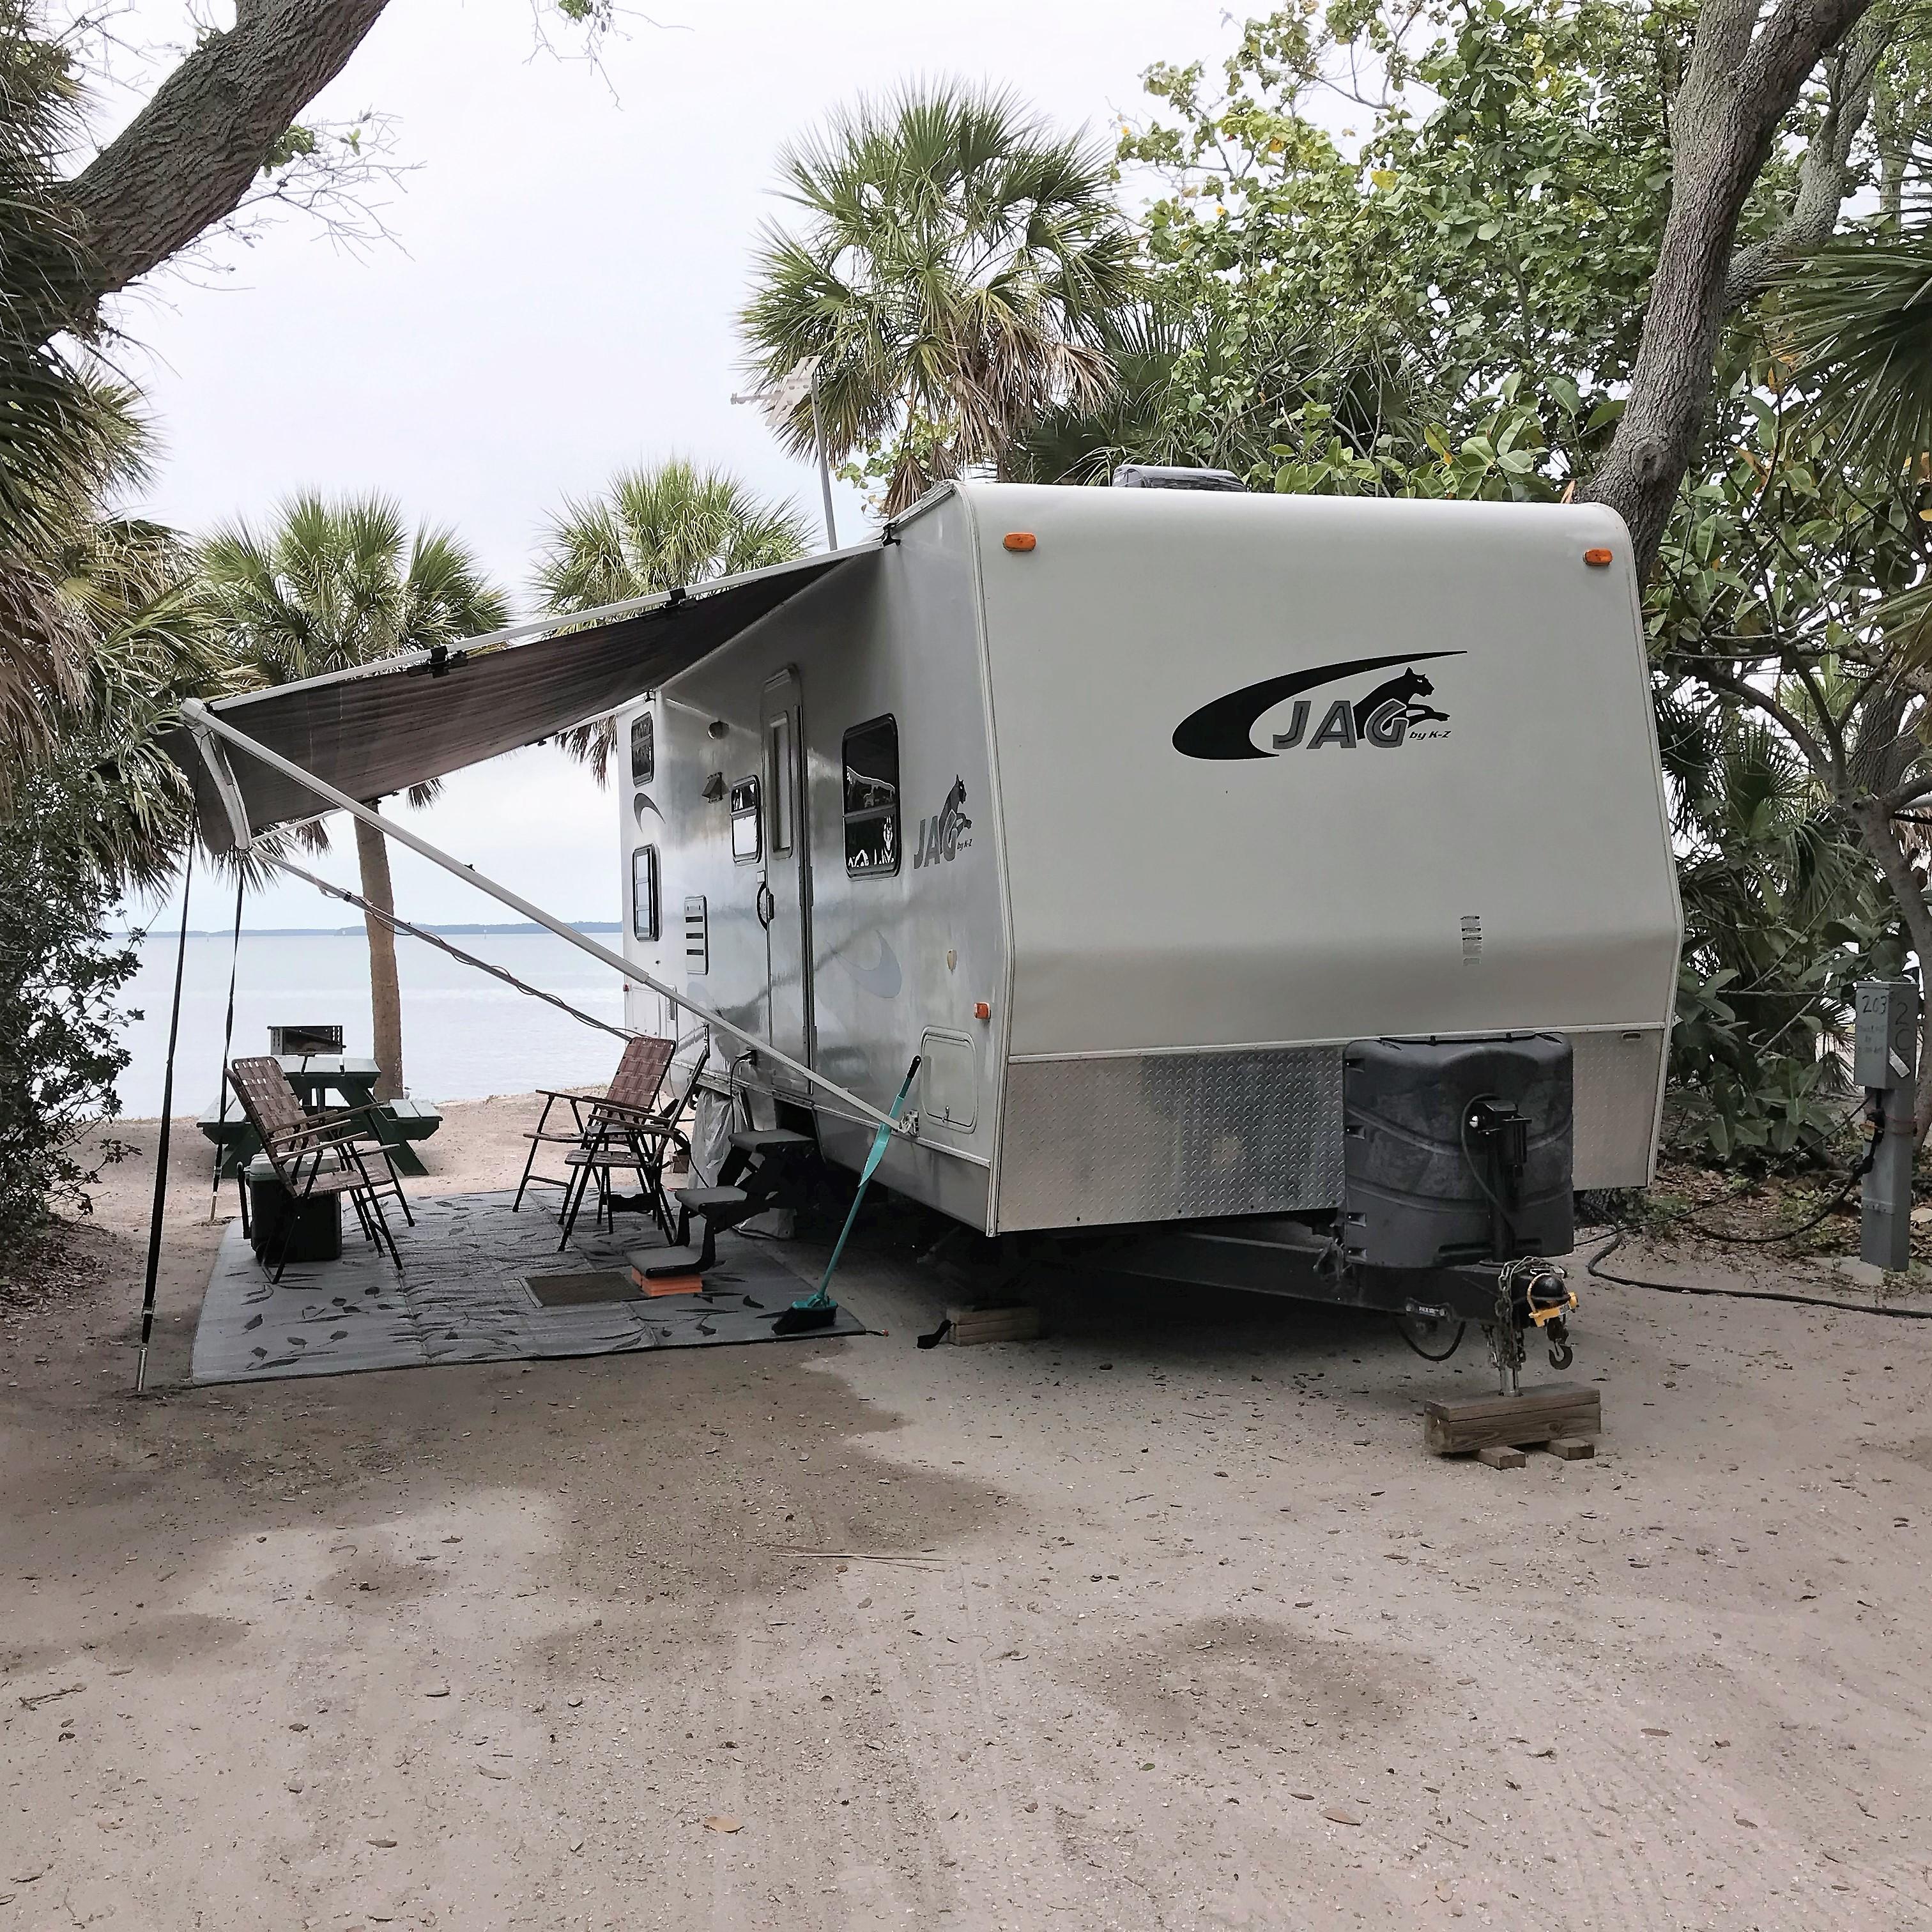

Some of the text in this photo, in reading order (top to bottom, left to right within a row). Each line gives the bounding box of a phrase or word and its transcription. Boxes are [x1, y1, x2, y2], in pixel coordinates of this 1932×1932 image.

[1273, 699, 1409, 749] JAG
[1409, 731, 1427, 740] by
[914, 809, 958, 870] JAG
